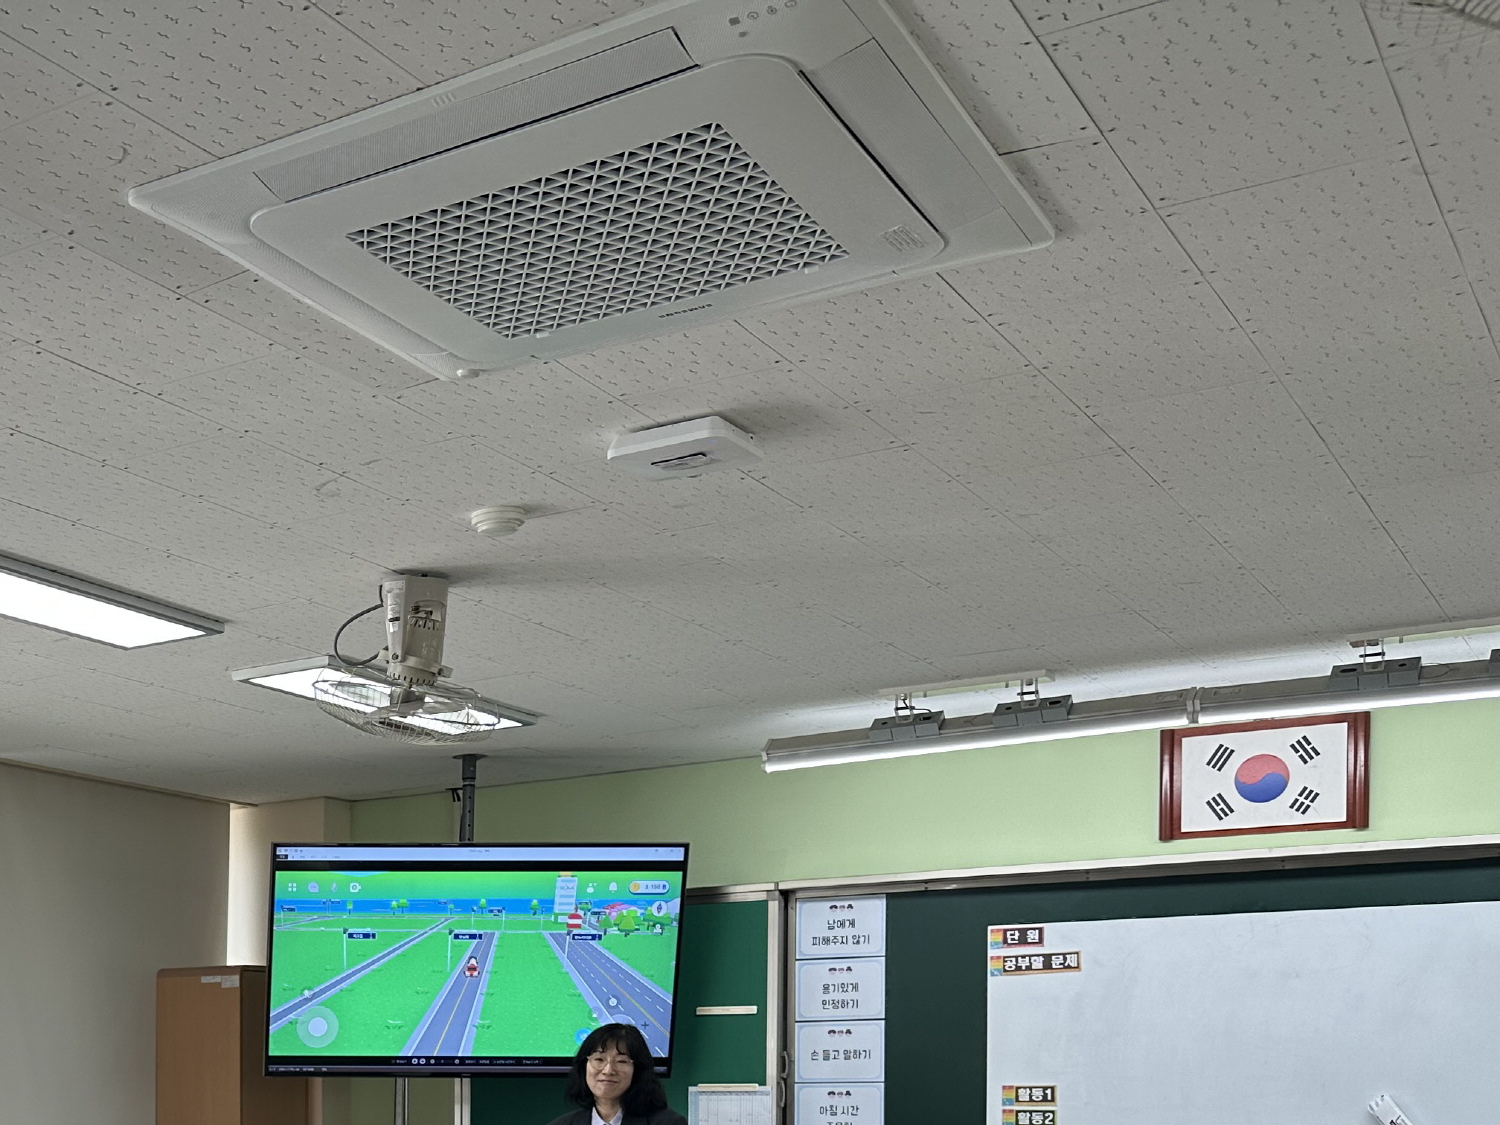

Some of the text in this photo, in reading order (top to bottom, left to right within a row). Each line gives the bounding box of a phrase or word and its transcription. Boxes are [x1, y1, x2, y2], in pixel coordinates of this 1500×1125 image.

[658, 303, 713, 318] SAMSUNG
[827, 918, 856, 931] 남에게
[811, 934, 870, 946] 피해주지 않기
[1004, 954, 1078, 971] 공부할 문제
[822, 982, 859, 995] 용기있게
[821, 998, 859, 1010] 인정하기
[810, 1049, 871, 1061] 손 들고 말하기
[1017, 1087, 1052, 1101] 활동1
[819, 1104, 859, 1116] 아침 시간
[1017, 1111, 1054, 1125] 활동2
